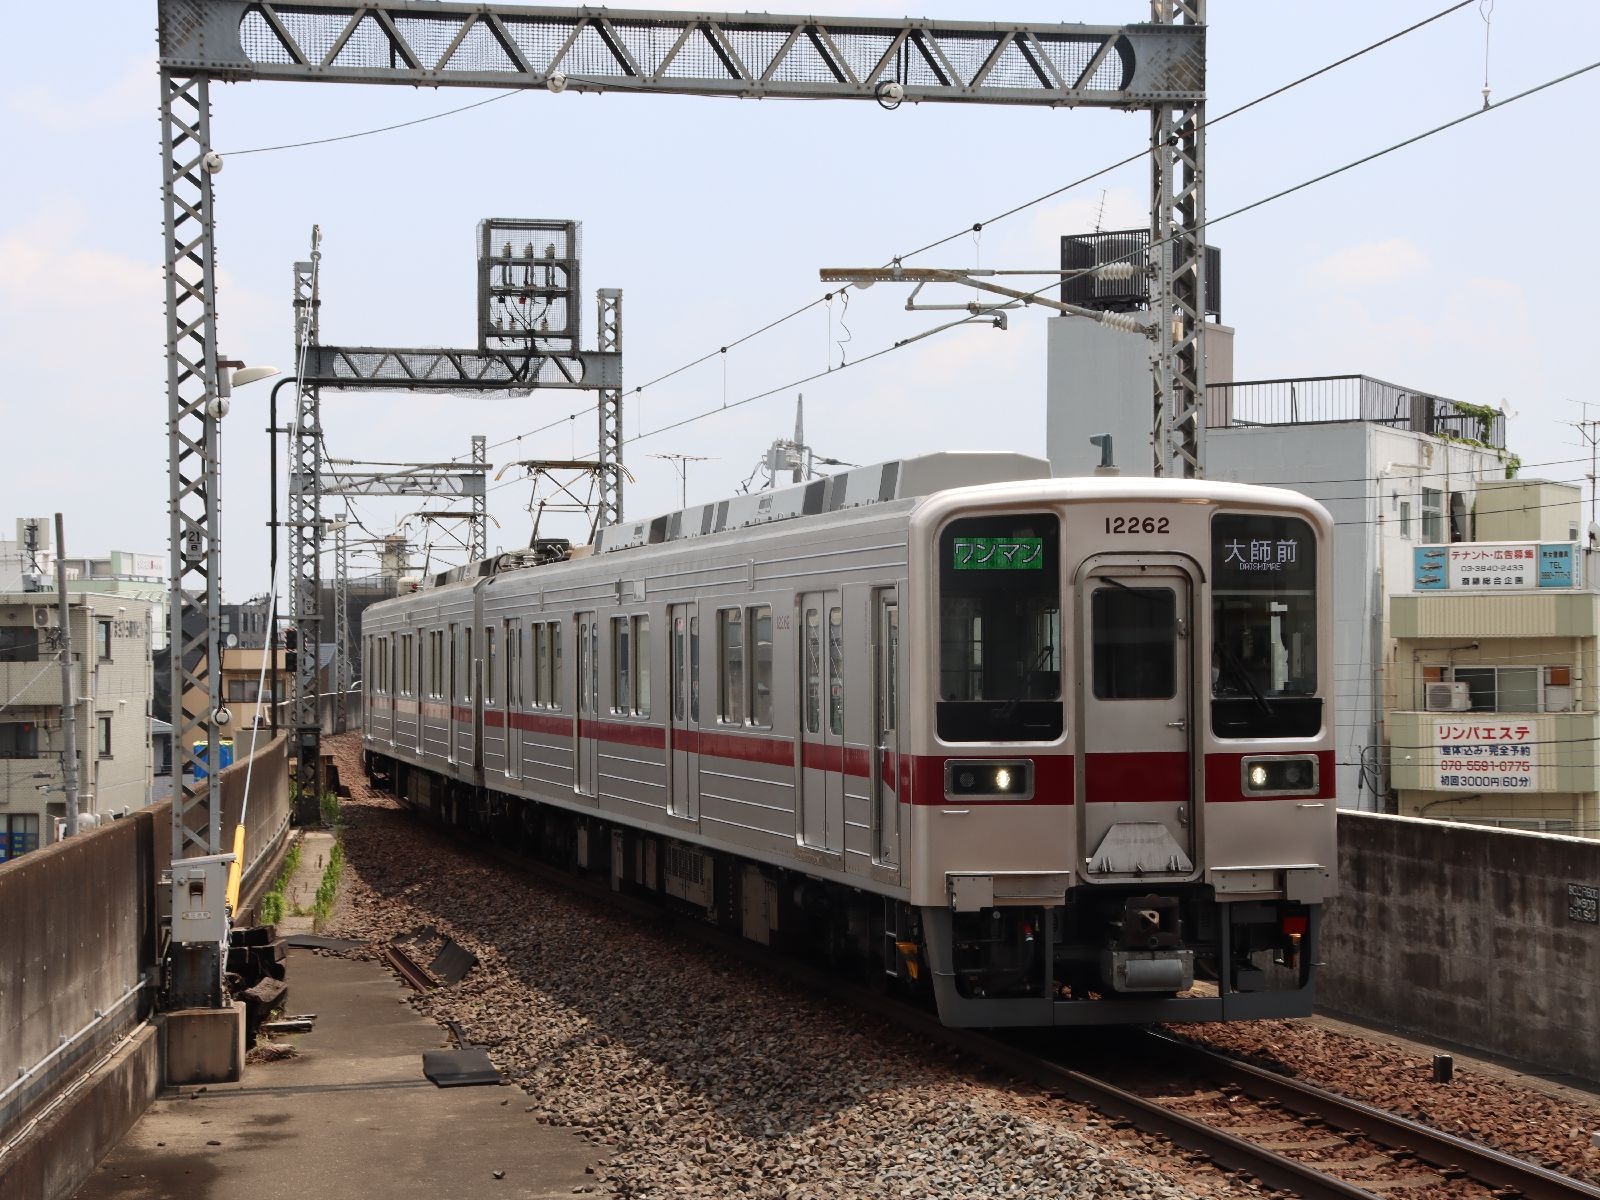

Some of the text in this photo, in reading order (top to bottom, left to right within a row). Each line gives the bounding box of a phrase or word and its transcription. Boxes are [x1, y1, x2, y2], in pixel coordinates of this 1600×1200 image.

[1105, 516, 1170, 534] 12262
[188, 531, 200, 542] 21
[955, 543, 1041, 564] ワンマン
[1224, 538, 1298, 563] 大師前
[1451, 550, 1534, 561] テナント・広告募集
[1239, 562, 1282, 571] DAISHIMAE
[1460, 564, 1524, 572] 03-3840-2433
[1549, 561, 1562, 569] TEL
[1439, 725, 1530, 740] リンパエステ
